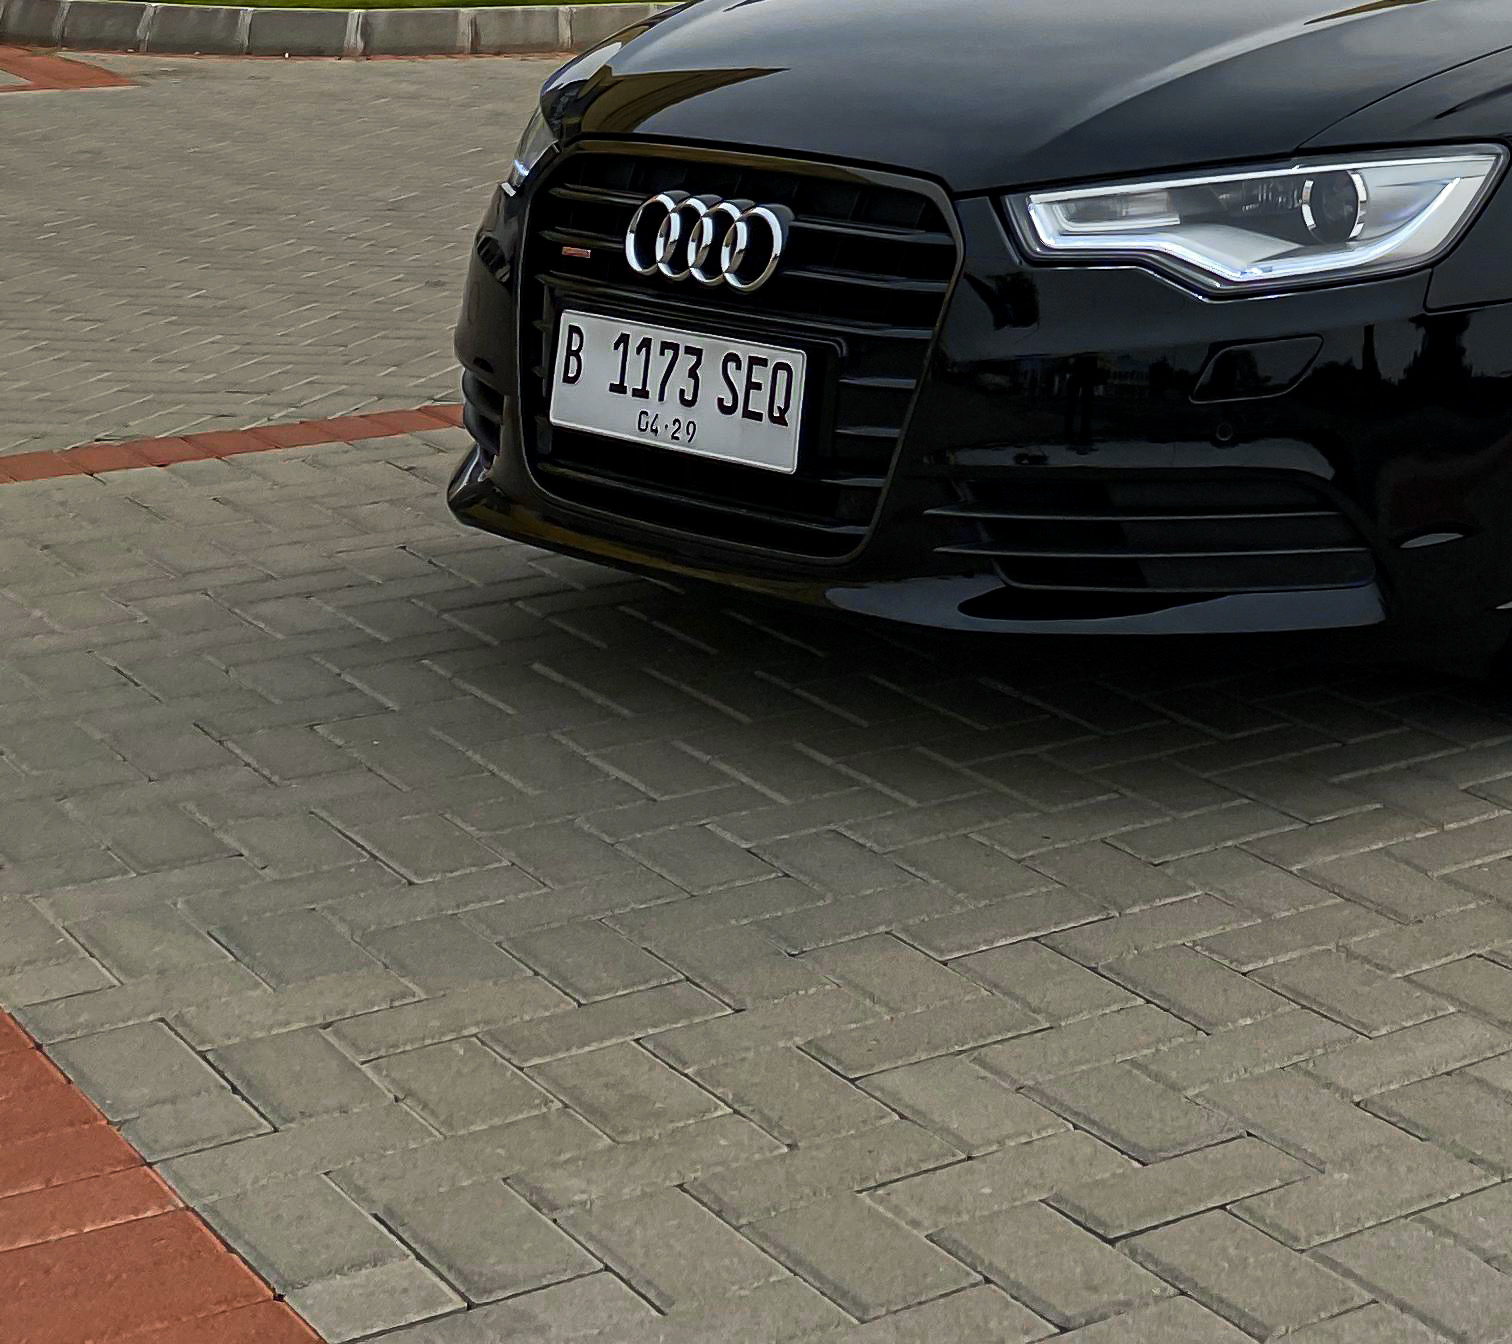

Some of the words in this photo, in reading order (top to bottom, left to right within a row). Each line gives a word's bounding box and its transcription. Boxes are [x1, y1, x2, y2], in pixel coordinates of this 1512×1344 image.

[562, 324, 585, 385] B
[608, 331, 704, 408] 1173
[717, 351, 794, 427] SEQ
